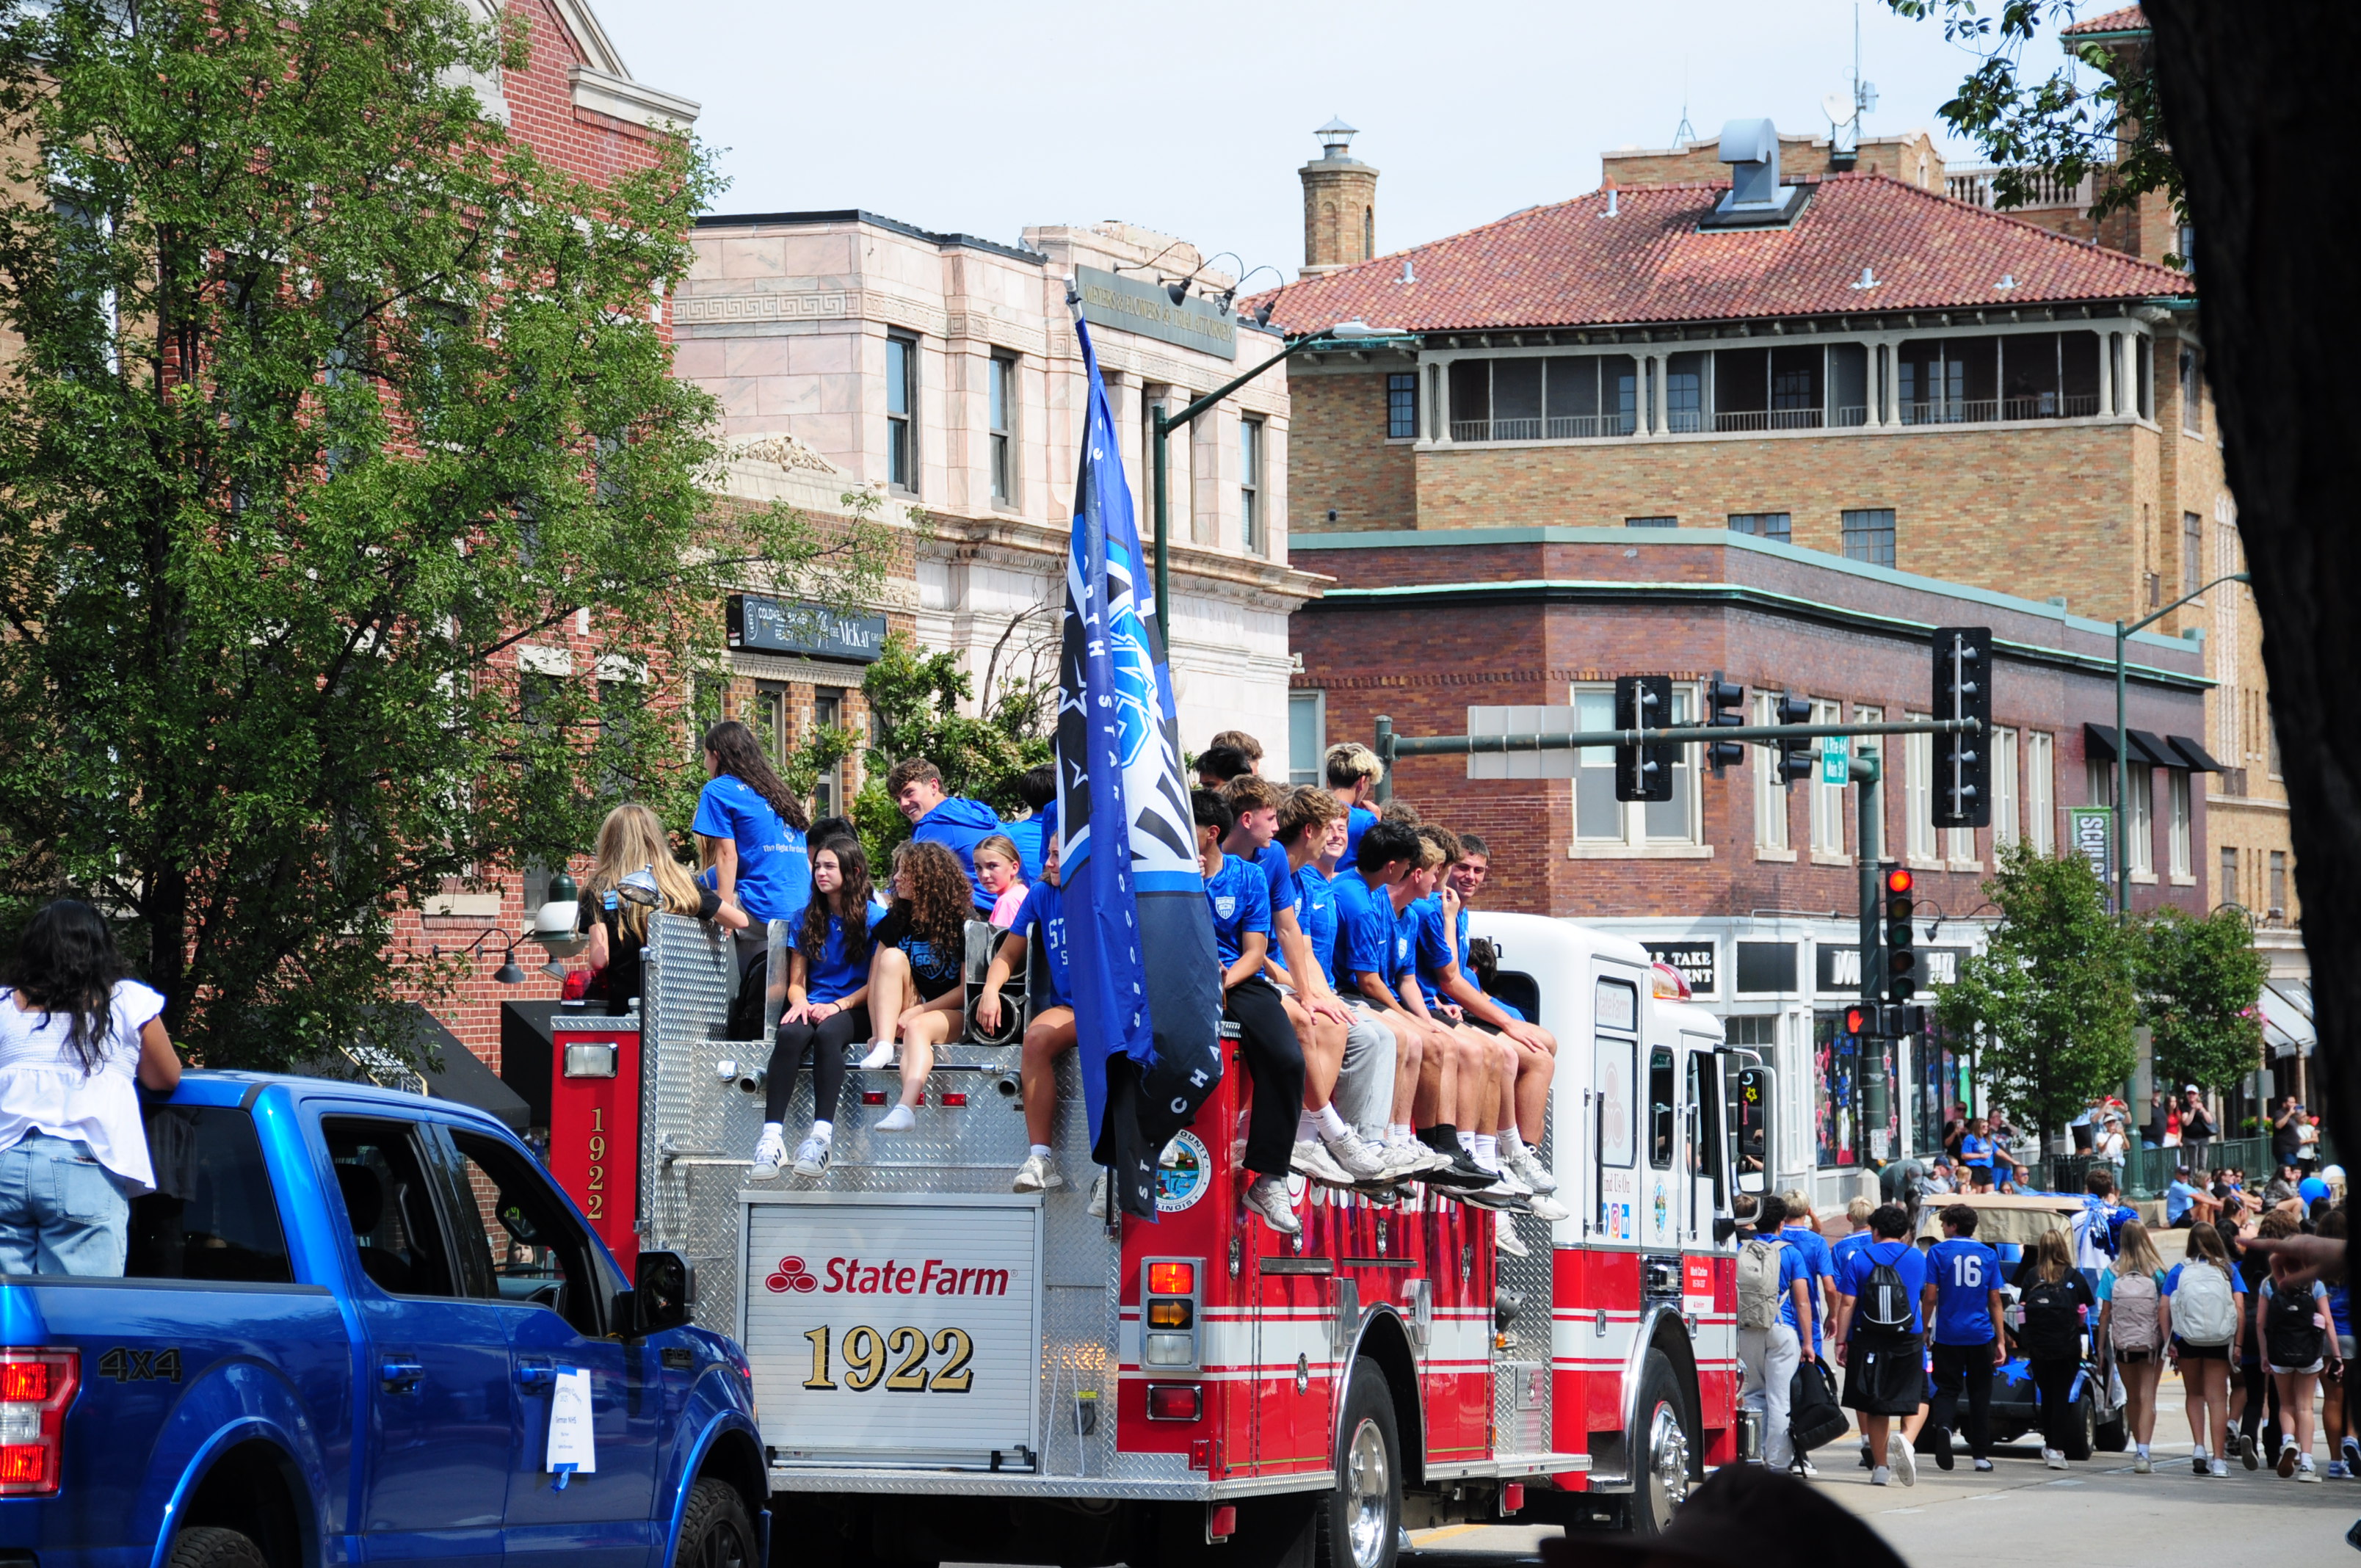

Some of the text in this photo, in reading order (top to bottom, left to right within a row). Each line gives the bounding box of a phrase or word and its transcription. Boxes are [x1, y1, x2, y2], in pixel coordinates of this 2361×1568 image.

[1084, 284, 1233, 343] MEYERS & FLOWERS TRIAL ATTORNEYS
[1672, 952, 1711, 966] TAKE
[1180, 1130, 1209, 1160] OUNTY
[587, 1107, 606, 1219] 1922
[1603, 1173, 1613, 1192] ind
[1156, 1199, 1193, 1211] LINOIS
[1954, 1255, 1981, 1288] 16
[802, 1324, 973, 1393] 1922
